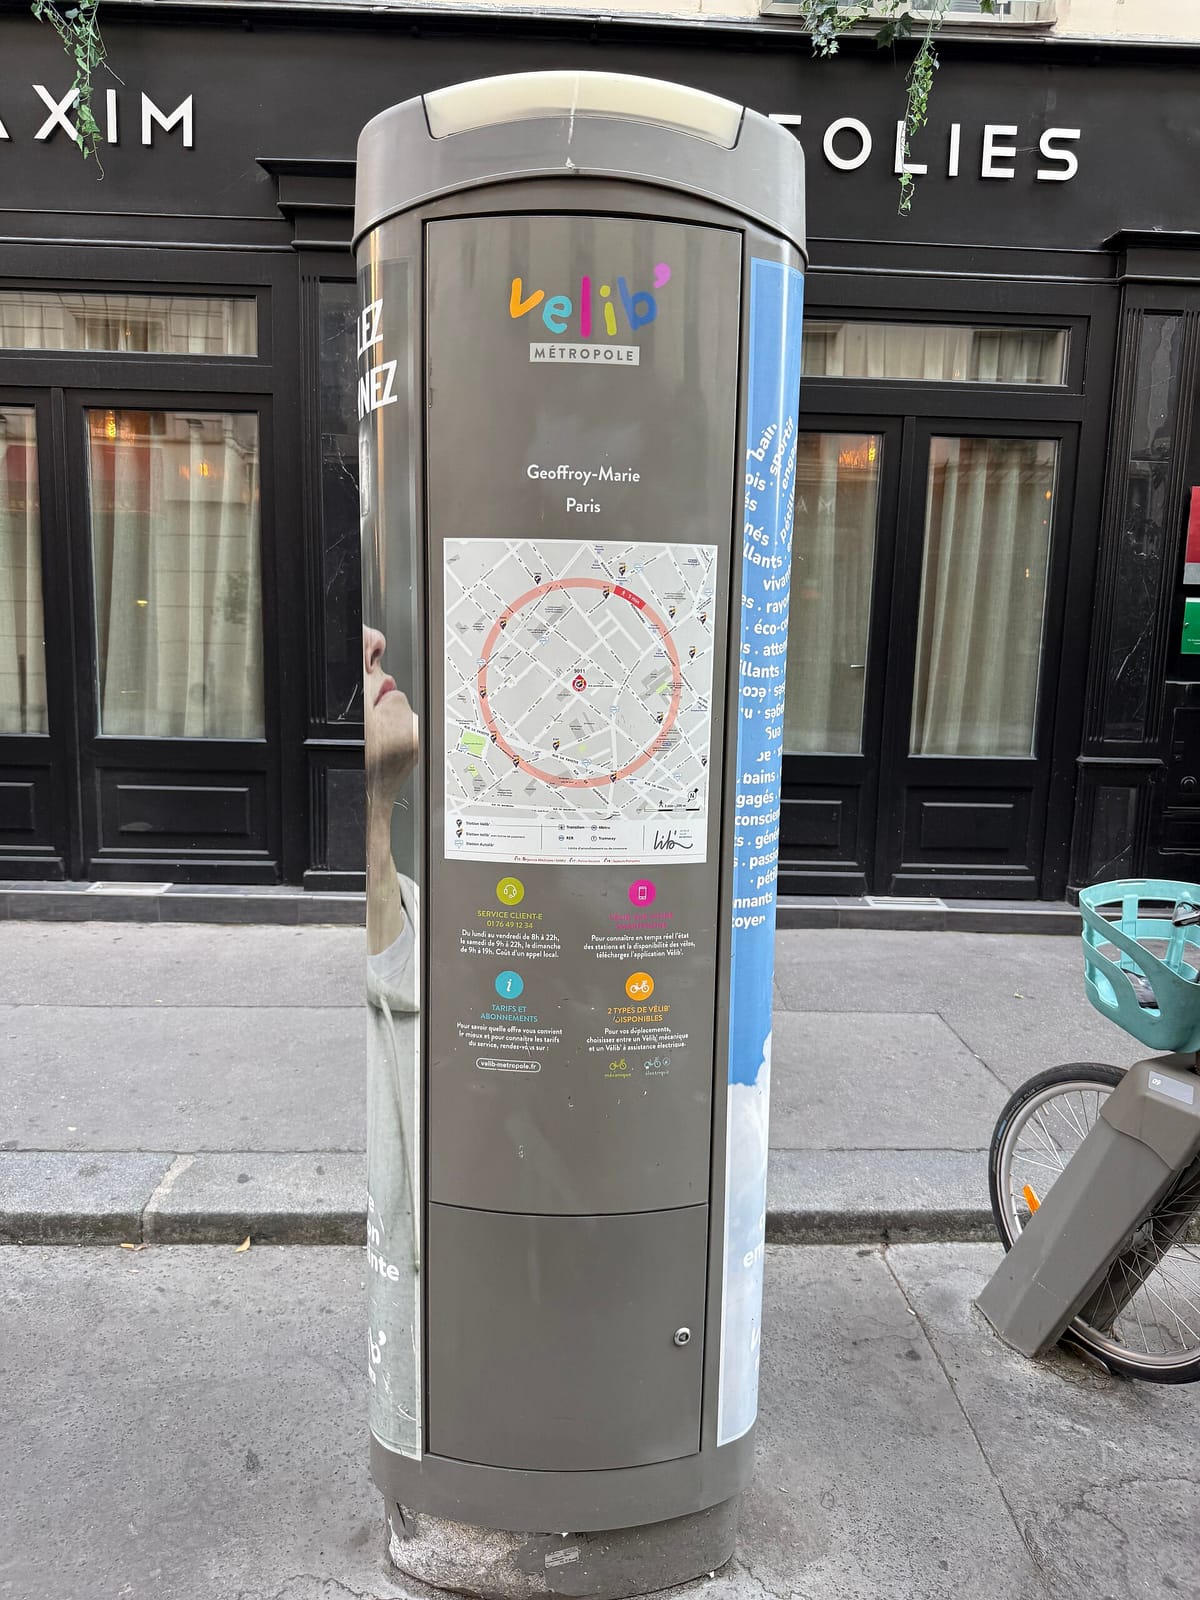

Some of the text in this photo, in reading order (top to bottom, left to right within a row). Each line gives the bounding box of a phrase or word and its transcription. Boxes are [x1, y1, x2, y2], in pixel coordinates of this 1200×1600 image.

[0, 84, 193, 147] XIM
[534, 345, 634, 361] MÉTROPOLE
[527, 464, 641, 486] Geoffroy-Marie
[566, 497, 601, 513] Paris
[743, 769, 776, 785] bains
[477, 910, 509, 918] SERVICE
[496, 932, 521, 940] vendredi
[532, 941, 560, 950] dimanche
[633, 942, 668, 951] disponibilité
[526, 951, 542, 959] appel
[630, 950, 665, 960] l'application
[492, 1004, 516, 1012] TARIFS
[481, 1013, 538, 1022] ABONNEMENTS
[614, 1014, 663, 1023] DISPONIBLES
[489, 1025, 506, 1034] quelle
